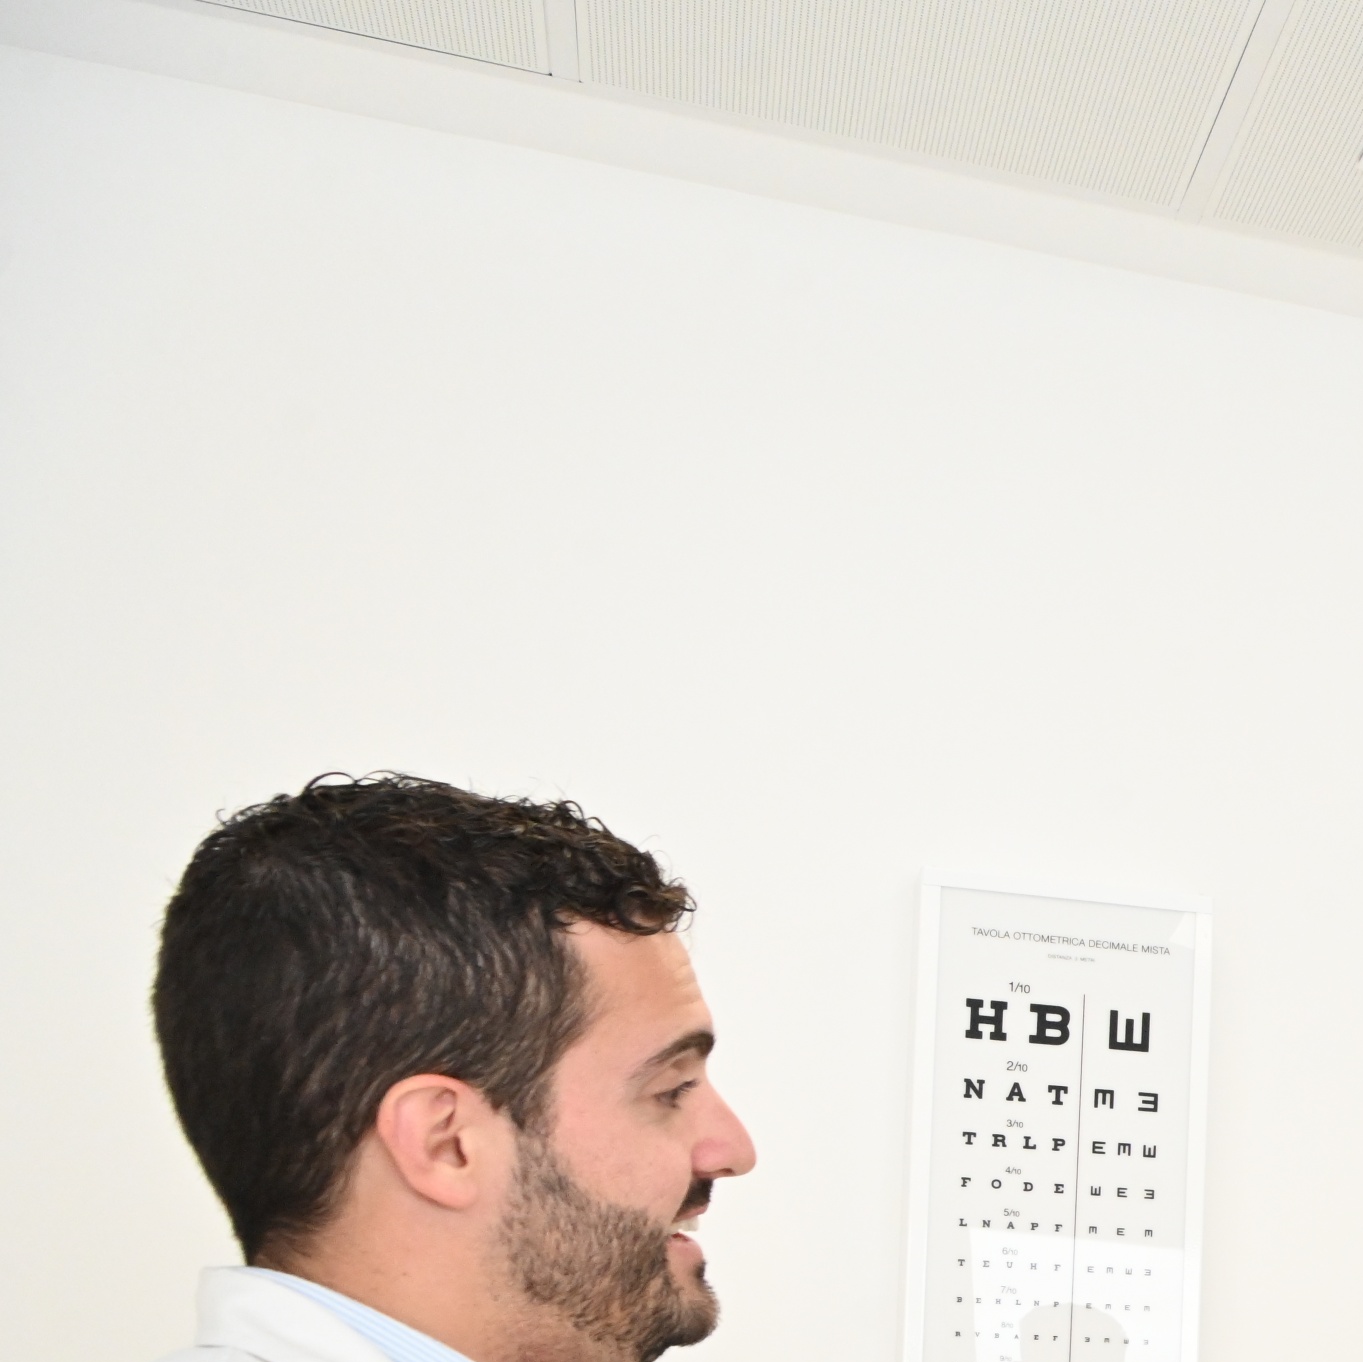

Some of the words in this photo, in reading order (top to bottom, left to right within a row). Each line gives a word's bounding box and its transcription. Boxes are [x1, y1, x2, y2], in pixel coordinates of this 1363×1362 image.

[971, 926, 1011, 939] TAVOLA
[1013, 931, 1086, 947] OTTOMETRICA
[1088, 939, 1139, 953] DECIMALE
[1141, 944, 1171, 956] MISTA
[1008, 981, 1031, 994] 1/10
[965, 998, 1008, 1041] H
[1029, 1004, 1070, 1045] B
[1006, 1060, 1028, 1073] 2/10
[964, 1078, 985, 1099] N
[1006, 1082, 1026, 1102] A
[1048, 1085, 1068, 1105] T
[1006, 1119, 1024, 1129] 3/10
[962, 1131, 977, 1146] T
[991, 1133, 1007, 1148] R
[1022, 1135, 1037, 1150] L
[1051, 1137, 1066, 1152] P
[1005, 1166, 1022, 1176] 4/10
[960, 1176, 972, 1188] F
[990, 1178, 1002, 1190] O
[1022, 1181, 1034, 1192] D
[1053, 1183, 1065, 1194] E
[1003, 1208, 1021, 1218] 5/10
[958, 1218, 968, 1227] L
[982, 1219, 991, 1228] N
[1006, 1221, 1015, 1230] A
[1030, 1222, 1039, 1231] P
[1054, 1223, 1063, 1233] F
[1002, 1247, 1019, 1256] 6/10
[957, 1258, 966, 1267] T
[982, 1260, 990, 1268] E
[1006, 1261, 1014, 1269] U
[1030, 1262, 1037, 1271] H
[1000, 1285, 1017, 1295] 7/10
